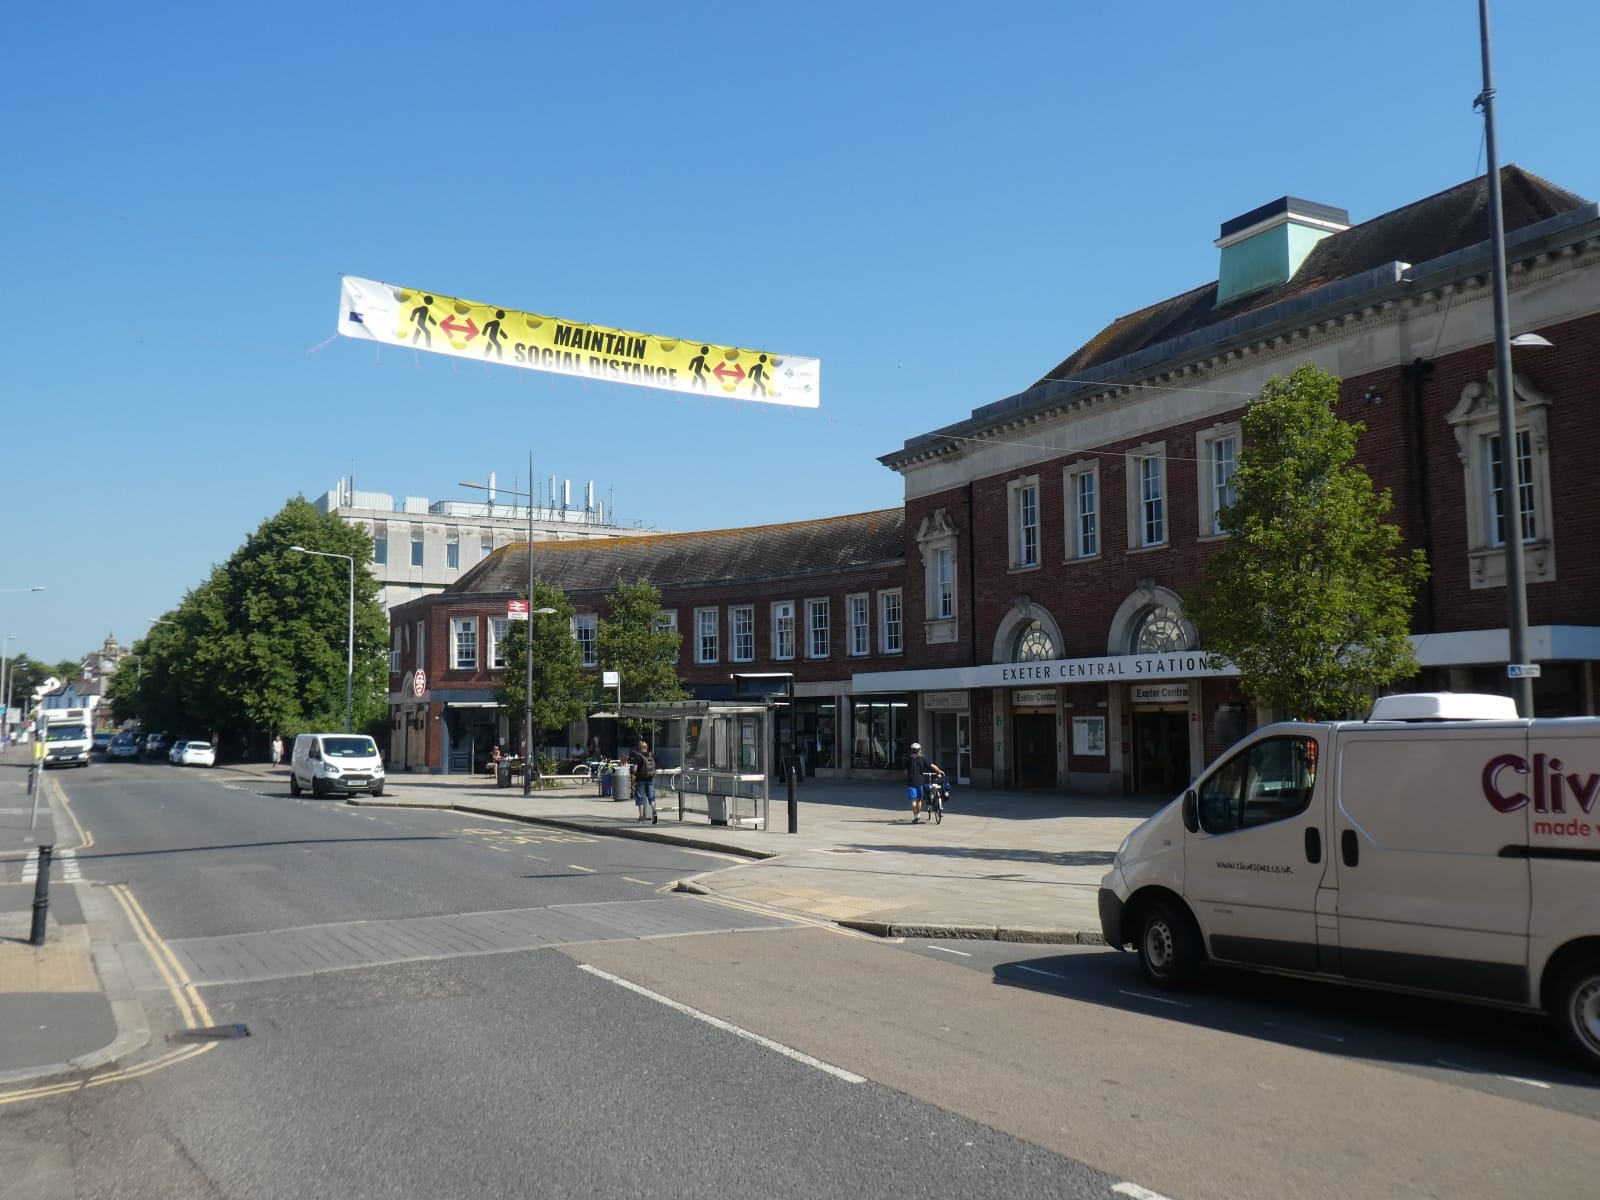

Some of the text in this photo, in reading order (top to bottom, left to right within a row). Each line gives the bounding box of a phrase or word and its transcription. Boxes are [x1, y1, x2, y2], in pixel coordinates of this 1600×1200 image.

[553, 324, 647, 360] MAINTAIN
[514, 342, 678, 387] SOCIAL DISTANCE
[1003, 657, 1208, 681] EXETER CENTRAL STATION
[1136, 687, 1161, 698] Exeter
[1482, 753, 1600, 814] Cliv
[1534, 818, 1591, 837] made
